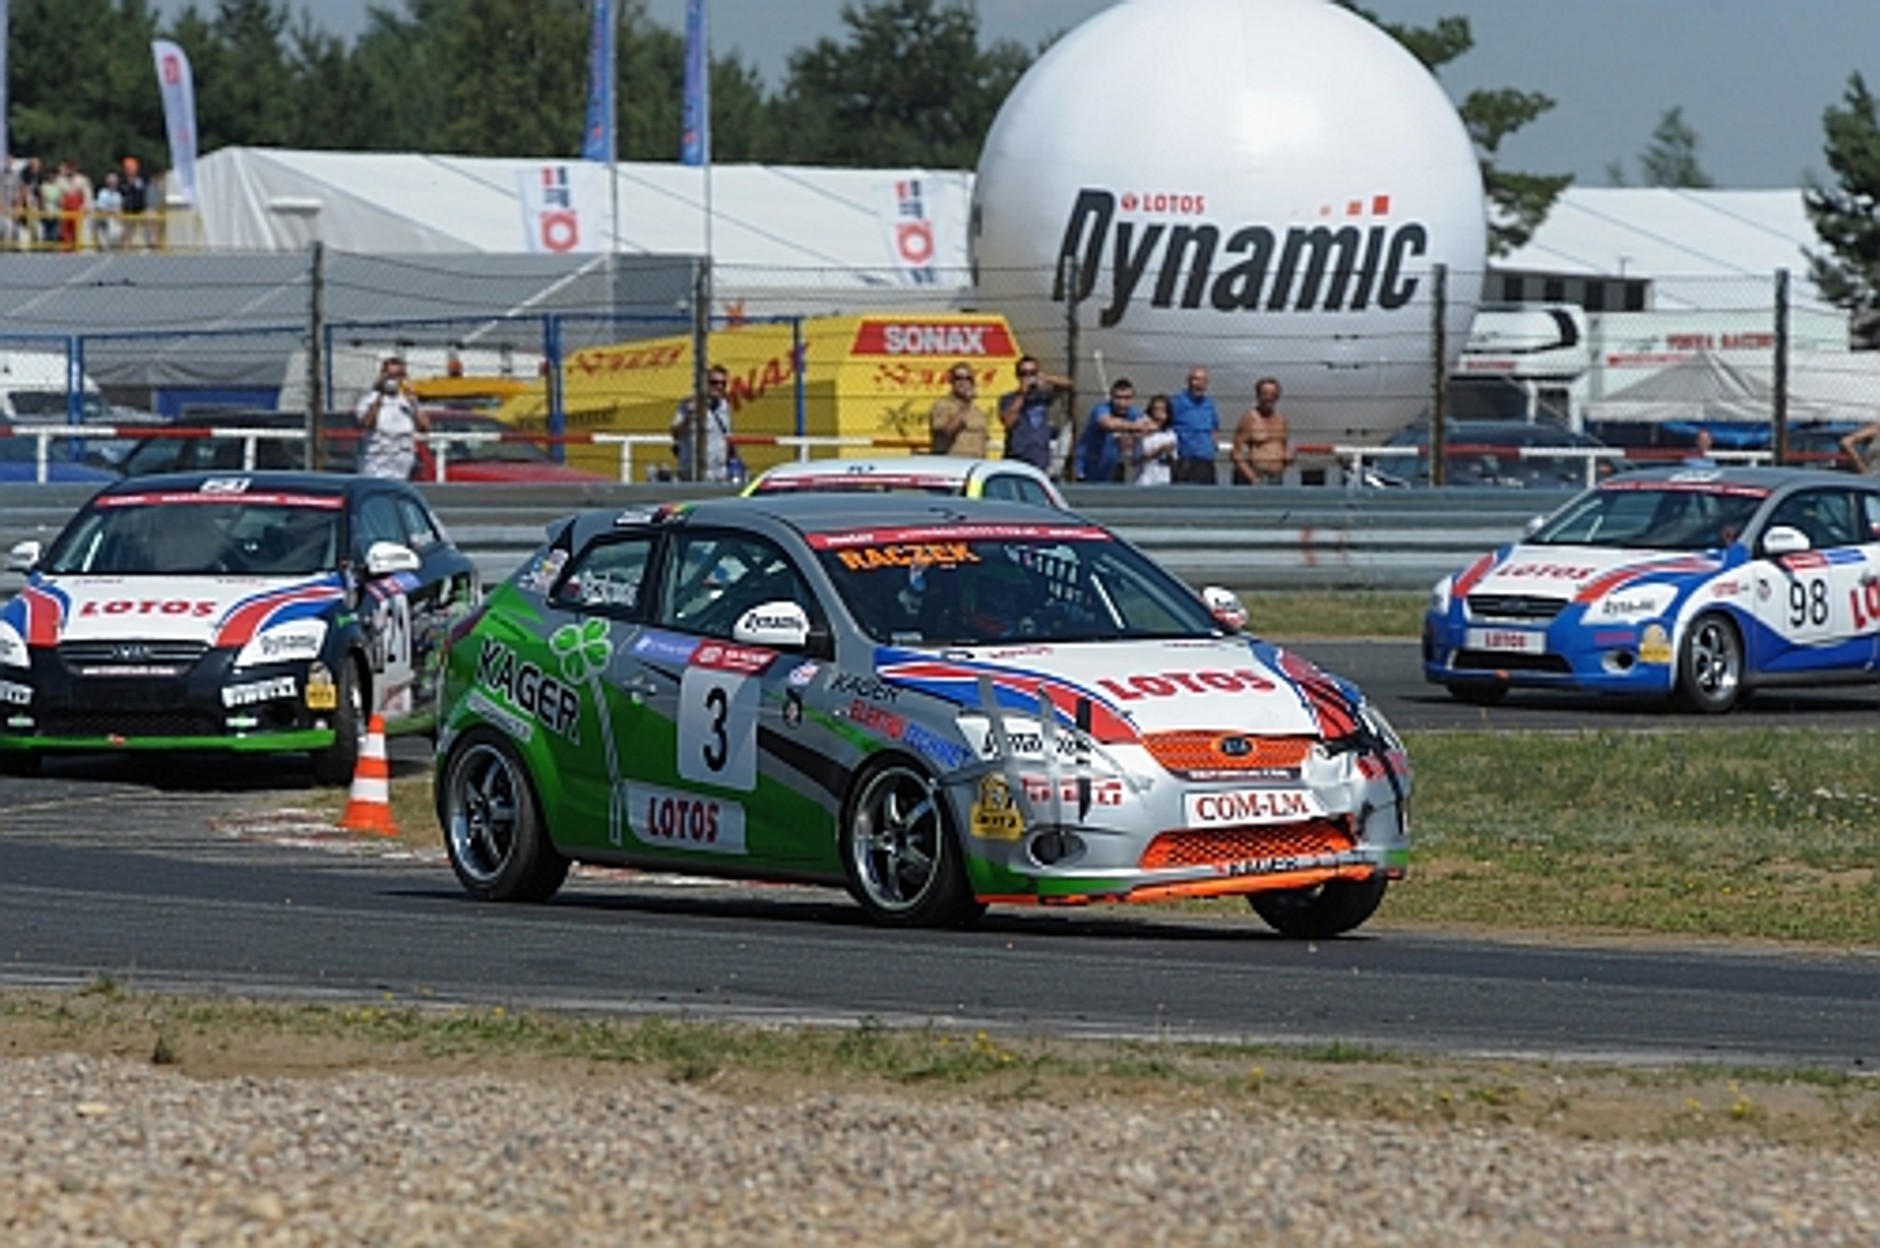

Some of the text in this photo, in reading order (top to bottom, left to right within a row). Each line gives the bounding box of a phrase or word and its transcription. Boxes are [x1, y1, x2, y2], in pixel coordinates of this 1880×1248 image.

[1143, 195, 1205, 214] LOTOS
[1052, 187, 1428, 328] Dynamic
[883, 325, 987, 355] SONAX
[837, 542, 981, 571] RACZEK
[1495, 563, 1596, 580] LOTOS
[79, 600, 216, 617] LOTOS
[1790, 578, 1829, 628] 98
[1096, 669, 1277, 701] LOTOS
[703, 687, 728, 773] 3
[647, 796, 720, 843] LOTOS
[1195, 792, 1310, 821] COM-LM
